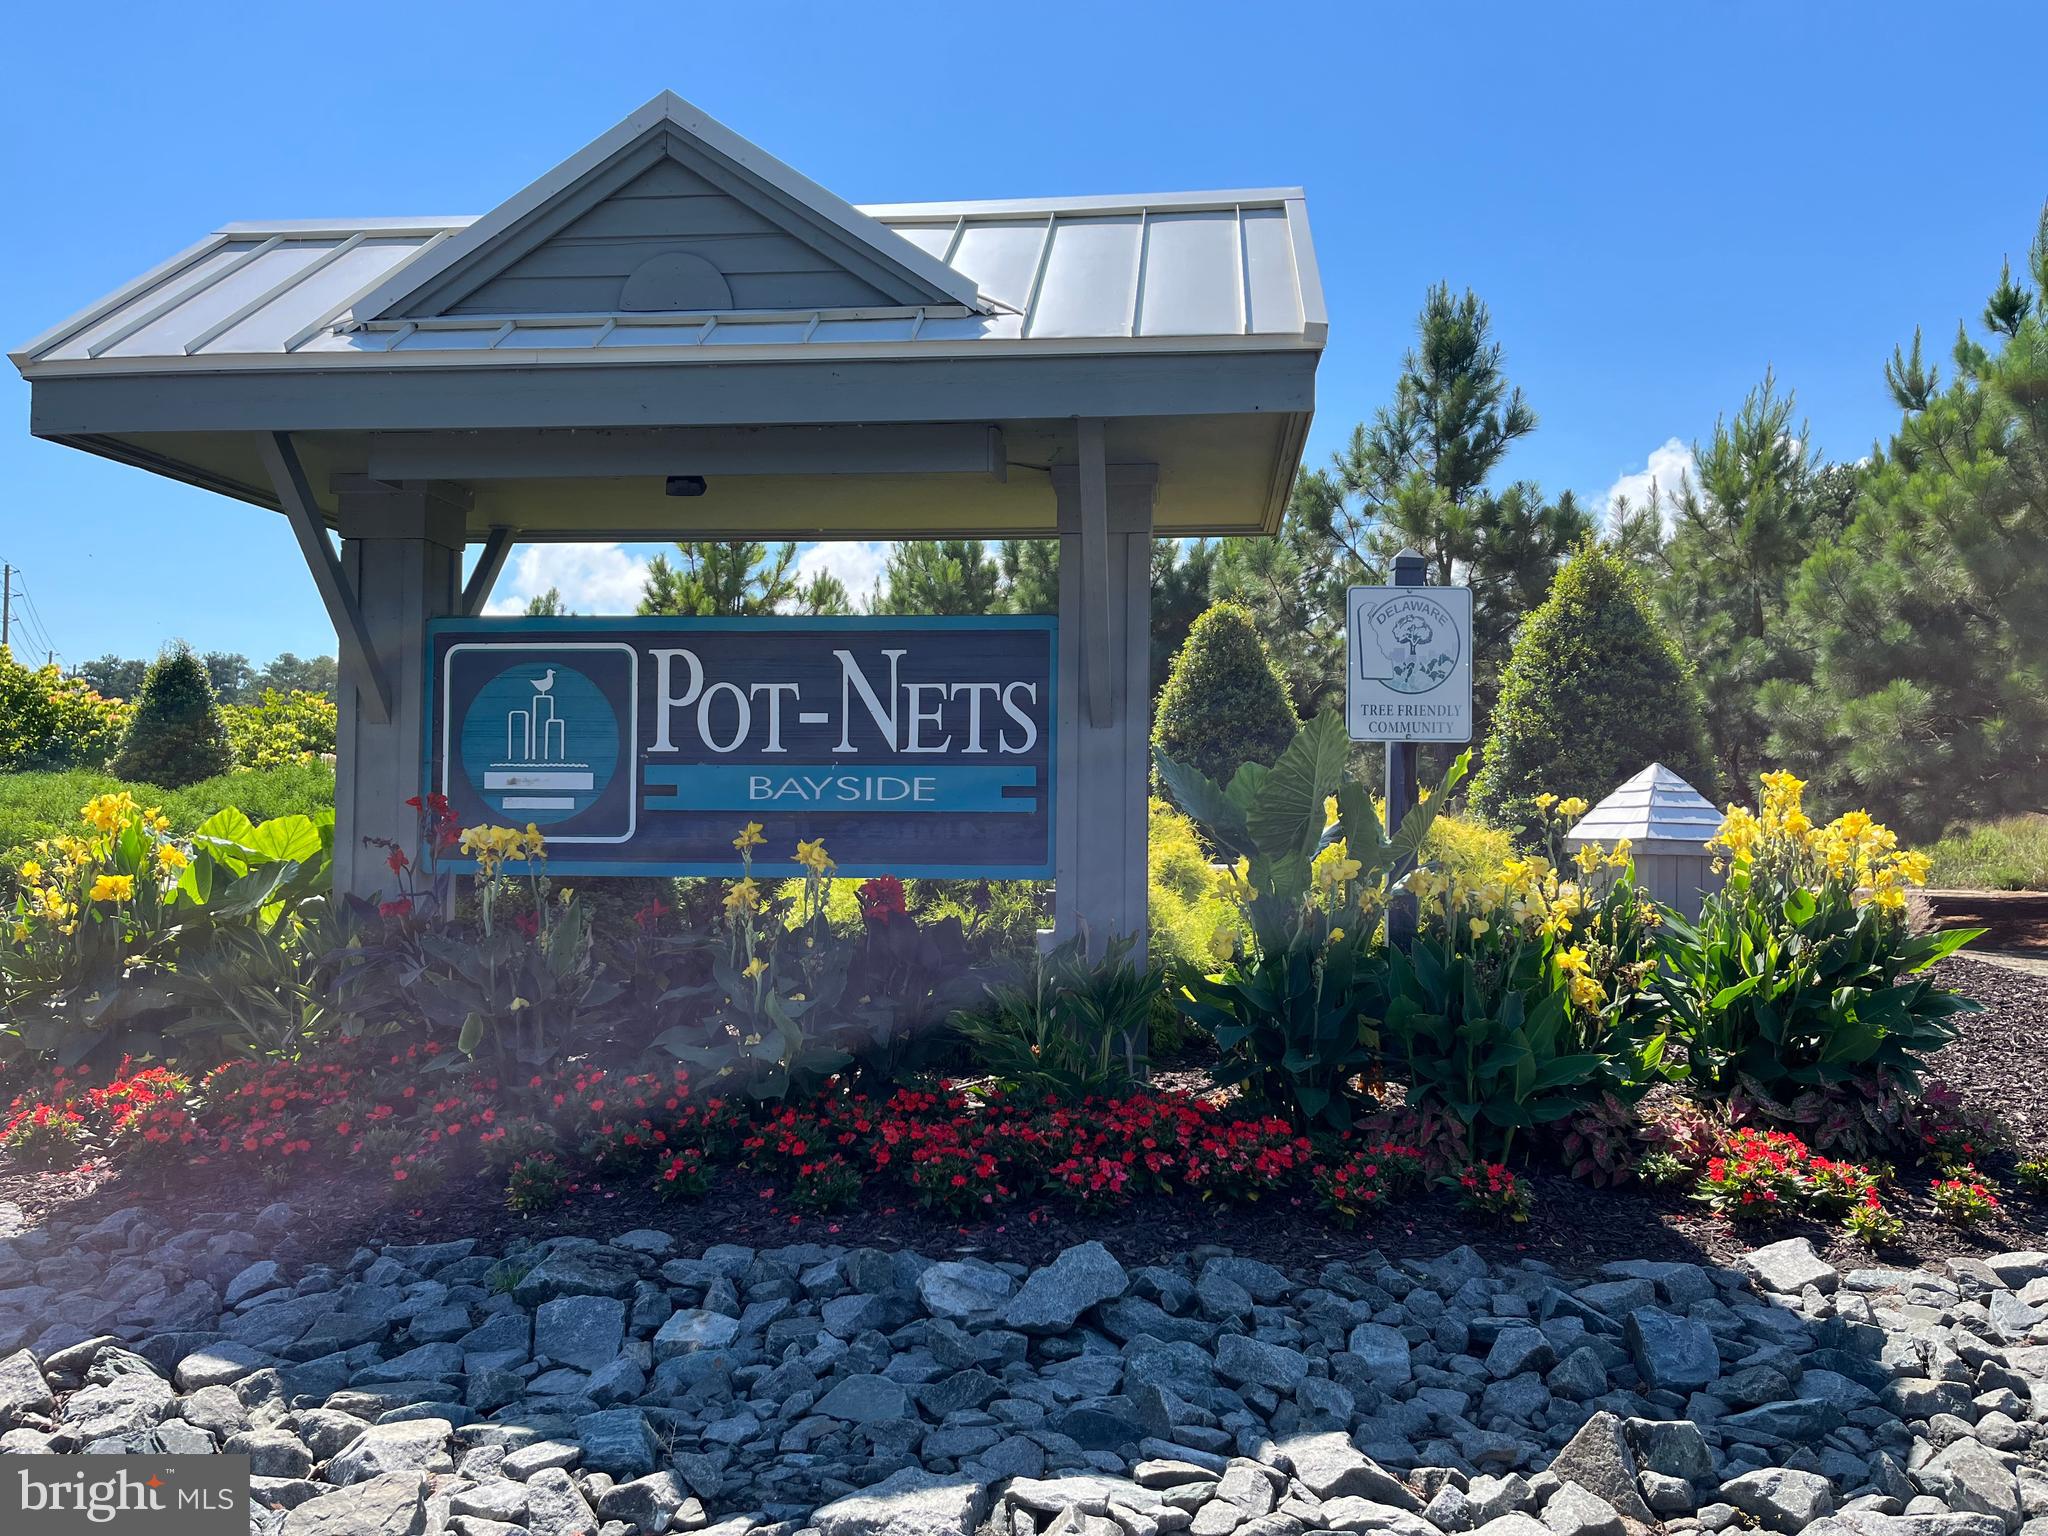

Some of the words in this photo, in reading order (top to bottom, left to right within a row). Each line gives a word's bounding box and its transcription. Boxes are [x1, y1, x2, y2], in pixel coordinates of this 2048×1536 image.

[1377, 601, 1448, 626] DELAWARE
[647, 648, 1038, 754] POT-NETS
[1361, 704, 1394, 716] TREE
[1398, 704, 1462, 717] FRIENDLY
[1368, 721, 1454, 733] COMMUNITY
[748, 776, 937, 802] BAYSIDE
